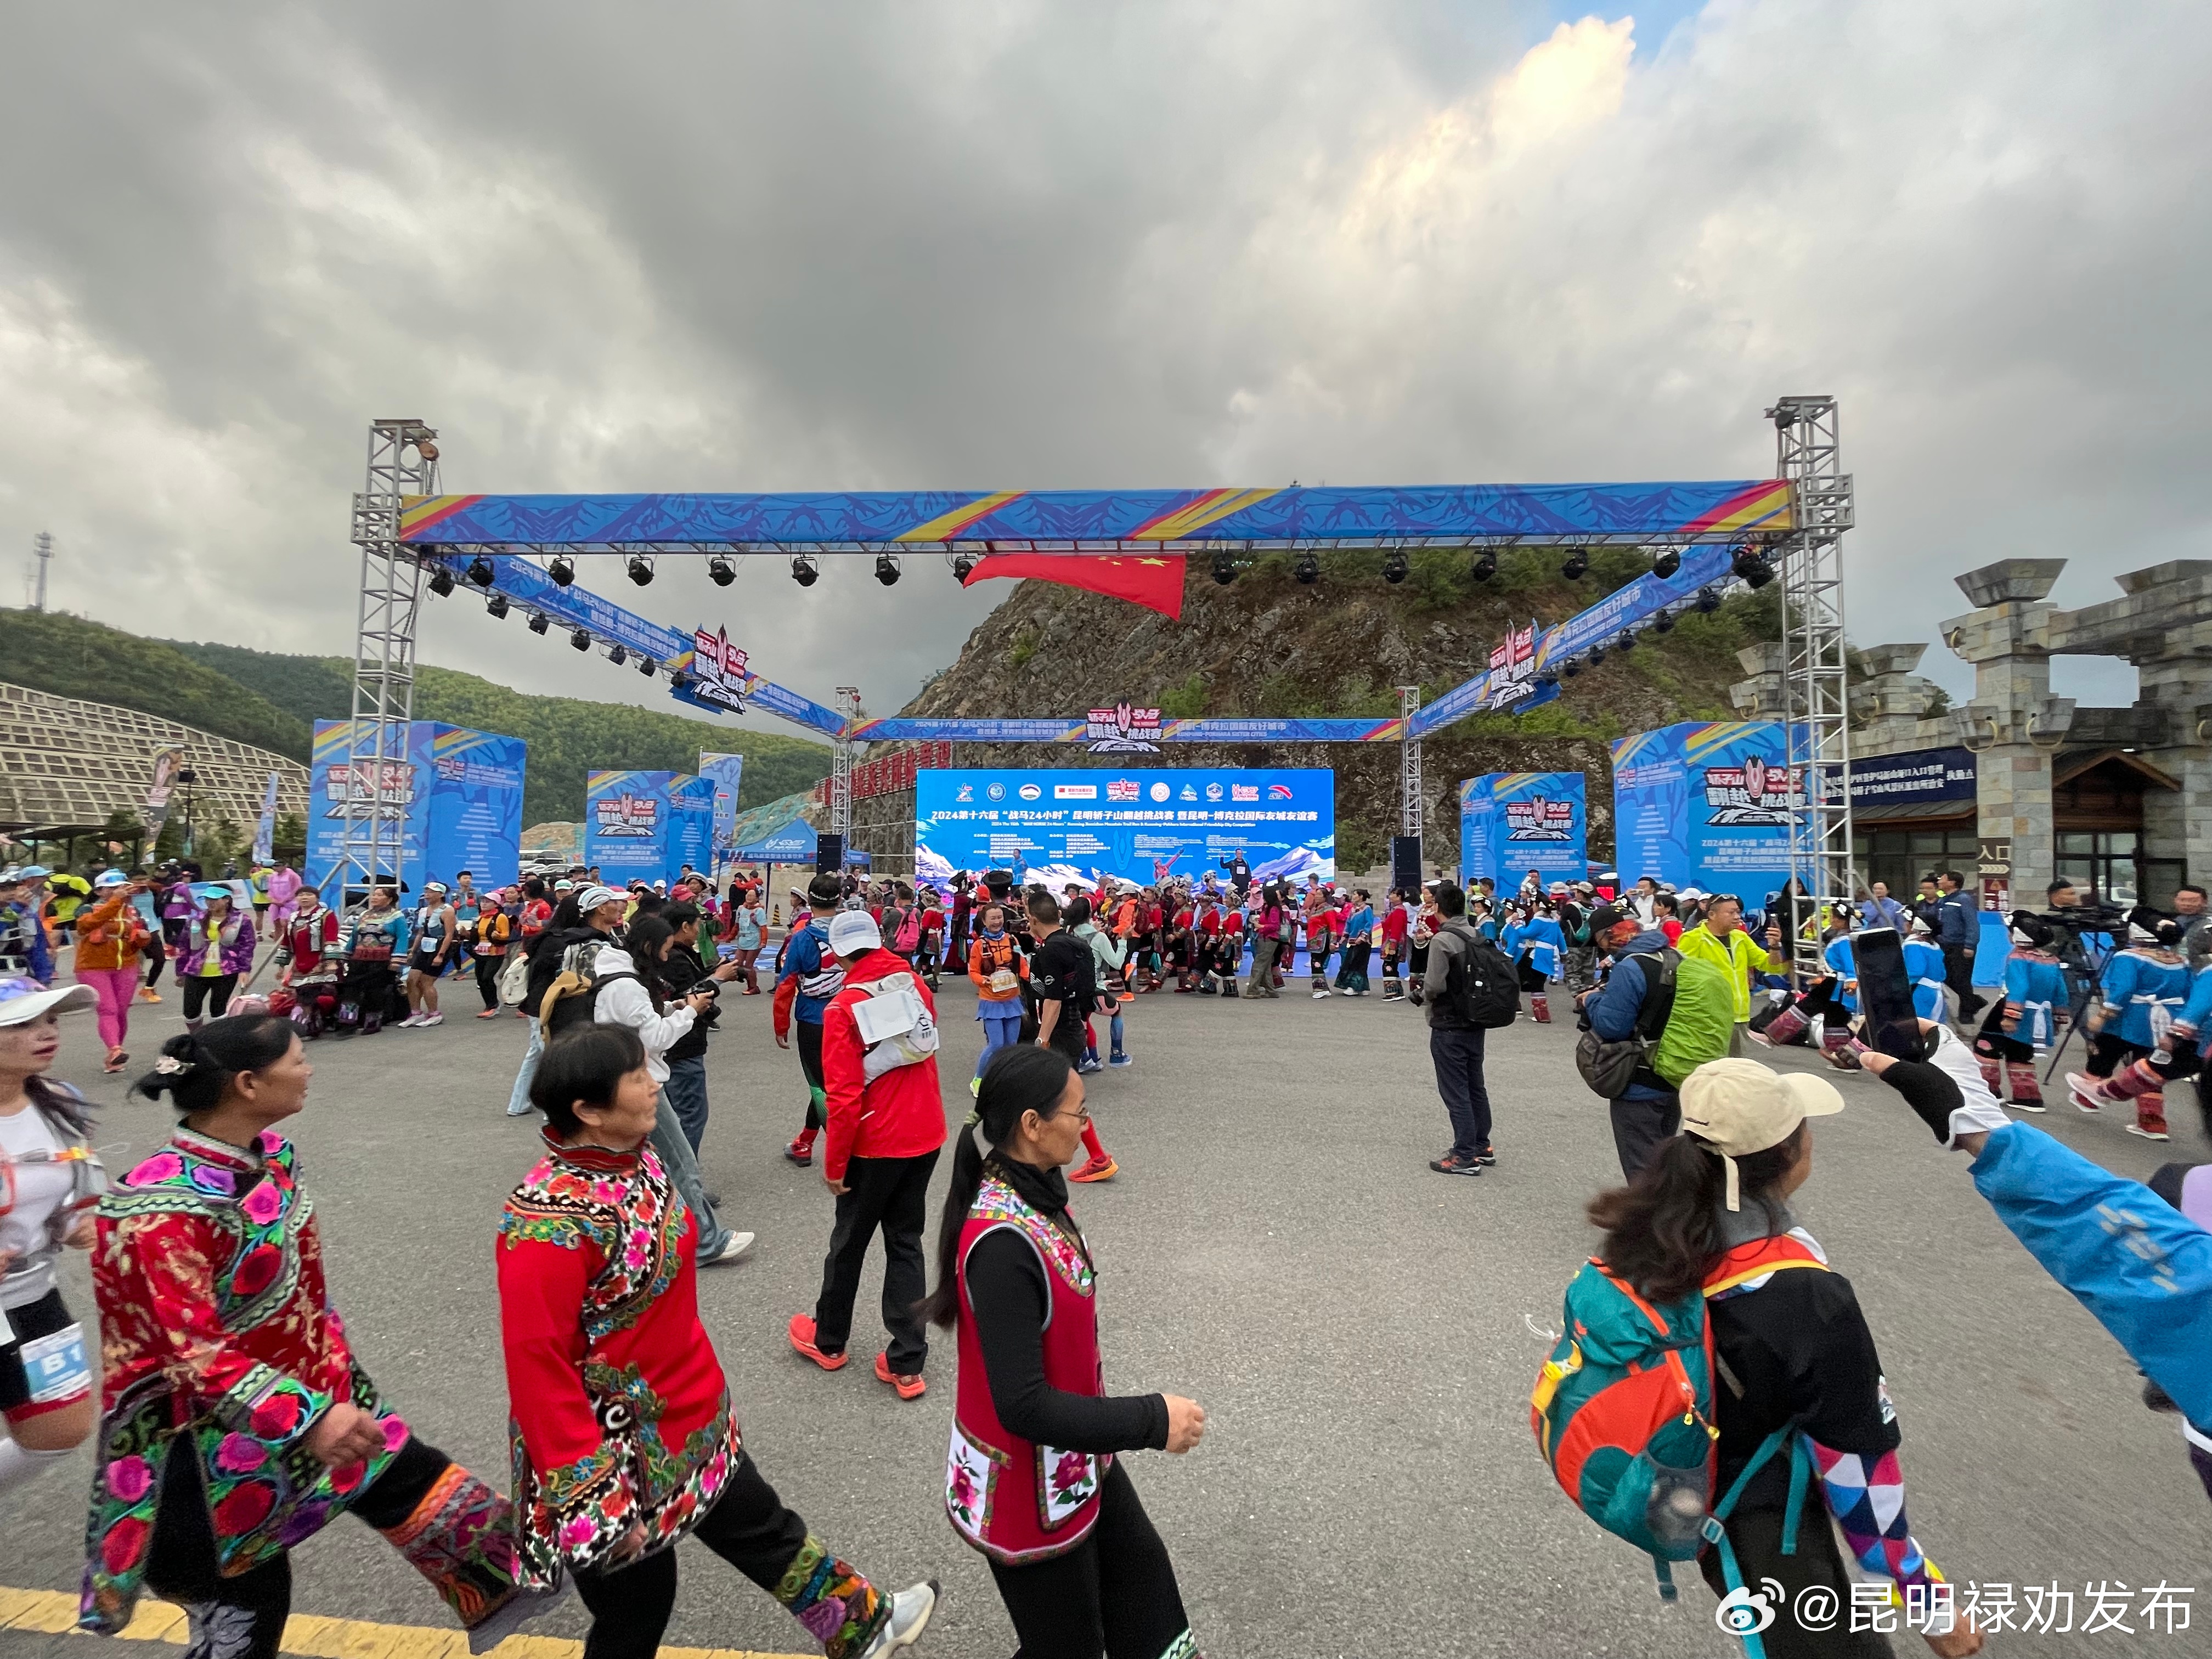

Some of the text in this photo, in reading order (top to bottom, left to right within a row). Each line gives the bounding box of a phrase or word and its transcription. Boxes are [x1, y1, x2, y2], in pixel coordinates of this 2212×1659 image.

[1087, 713, 1116, 723] 轿子山
[1087, 723, 1163, 740] 翻越 挑战赛
[1707, 773, 1745, 785] 轿子山
[1706, 787, 1751, 805] 翻越
[1977, 845, 2012, 861] 入口
